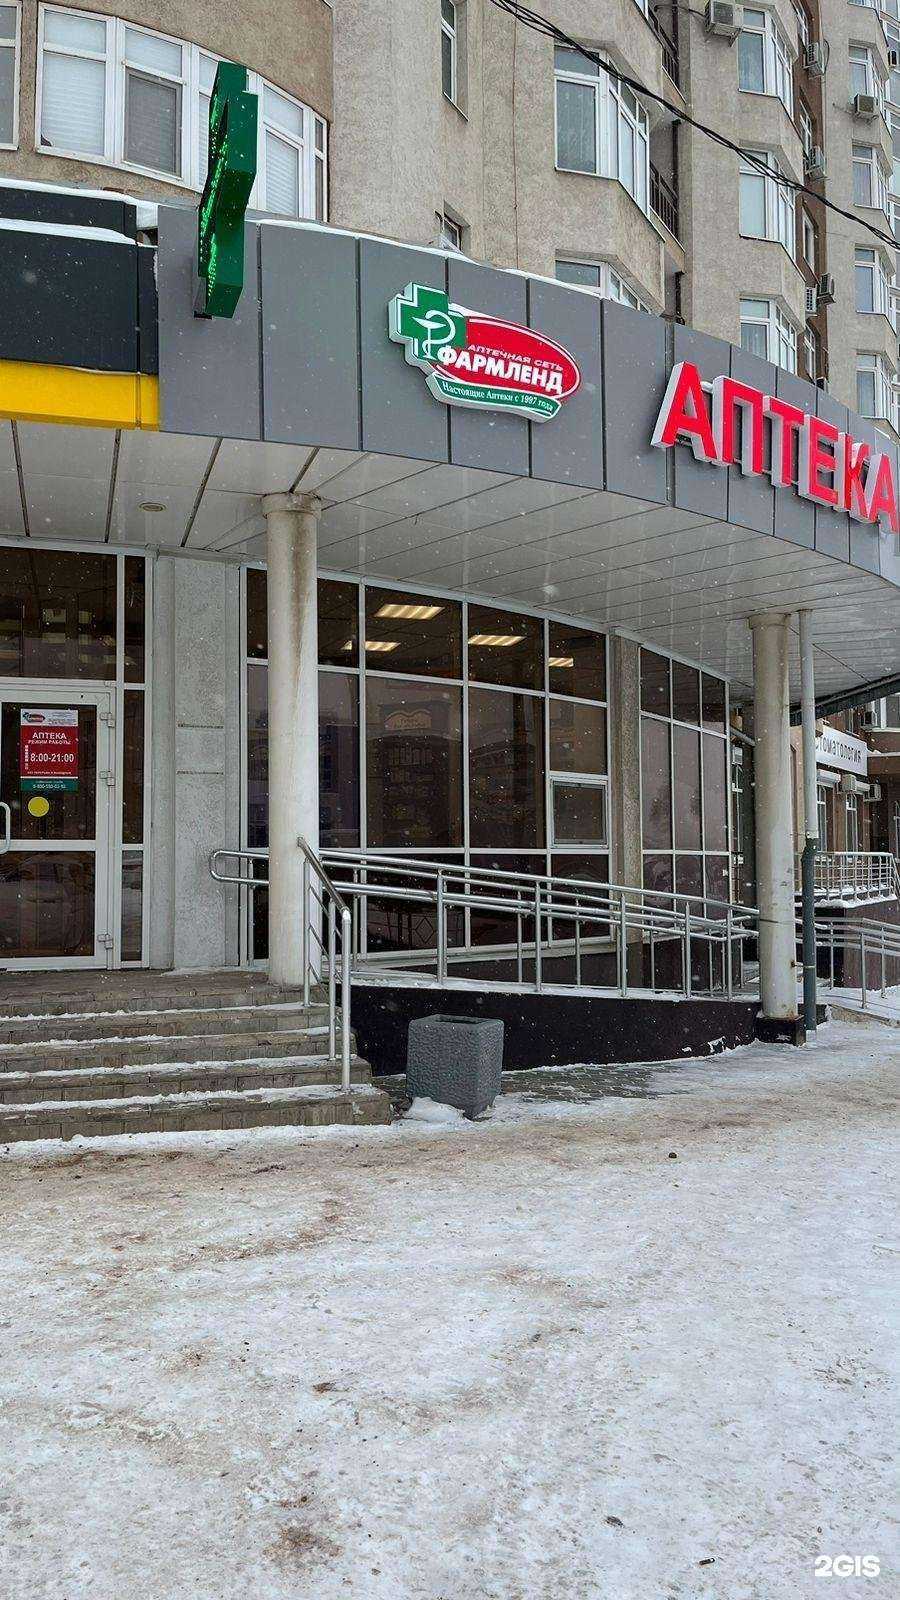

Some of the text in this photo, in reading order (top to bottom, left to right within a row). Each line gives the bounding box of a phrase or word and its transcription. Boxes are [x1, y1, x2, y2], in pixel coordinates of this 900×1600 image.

[437, 345, 563, 395] ФАРМЛЕНД
[467, 344, 564, 371] АПТЕЧНАЯ СЕТЬ
[441, 380, 485, 398] Настоящие
[486, 390, 513, 402] Аптеки
[521, 394, 538, 405] 1997
[538, 399, 554, 411] года
[651, 360, 899, 537] АПТЕКА
[32, 732, 67, 740] АПТЕКА
[30, 753, 74, 763] 8:00-21:00
